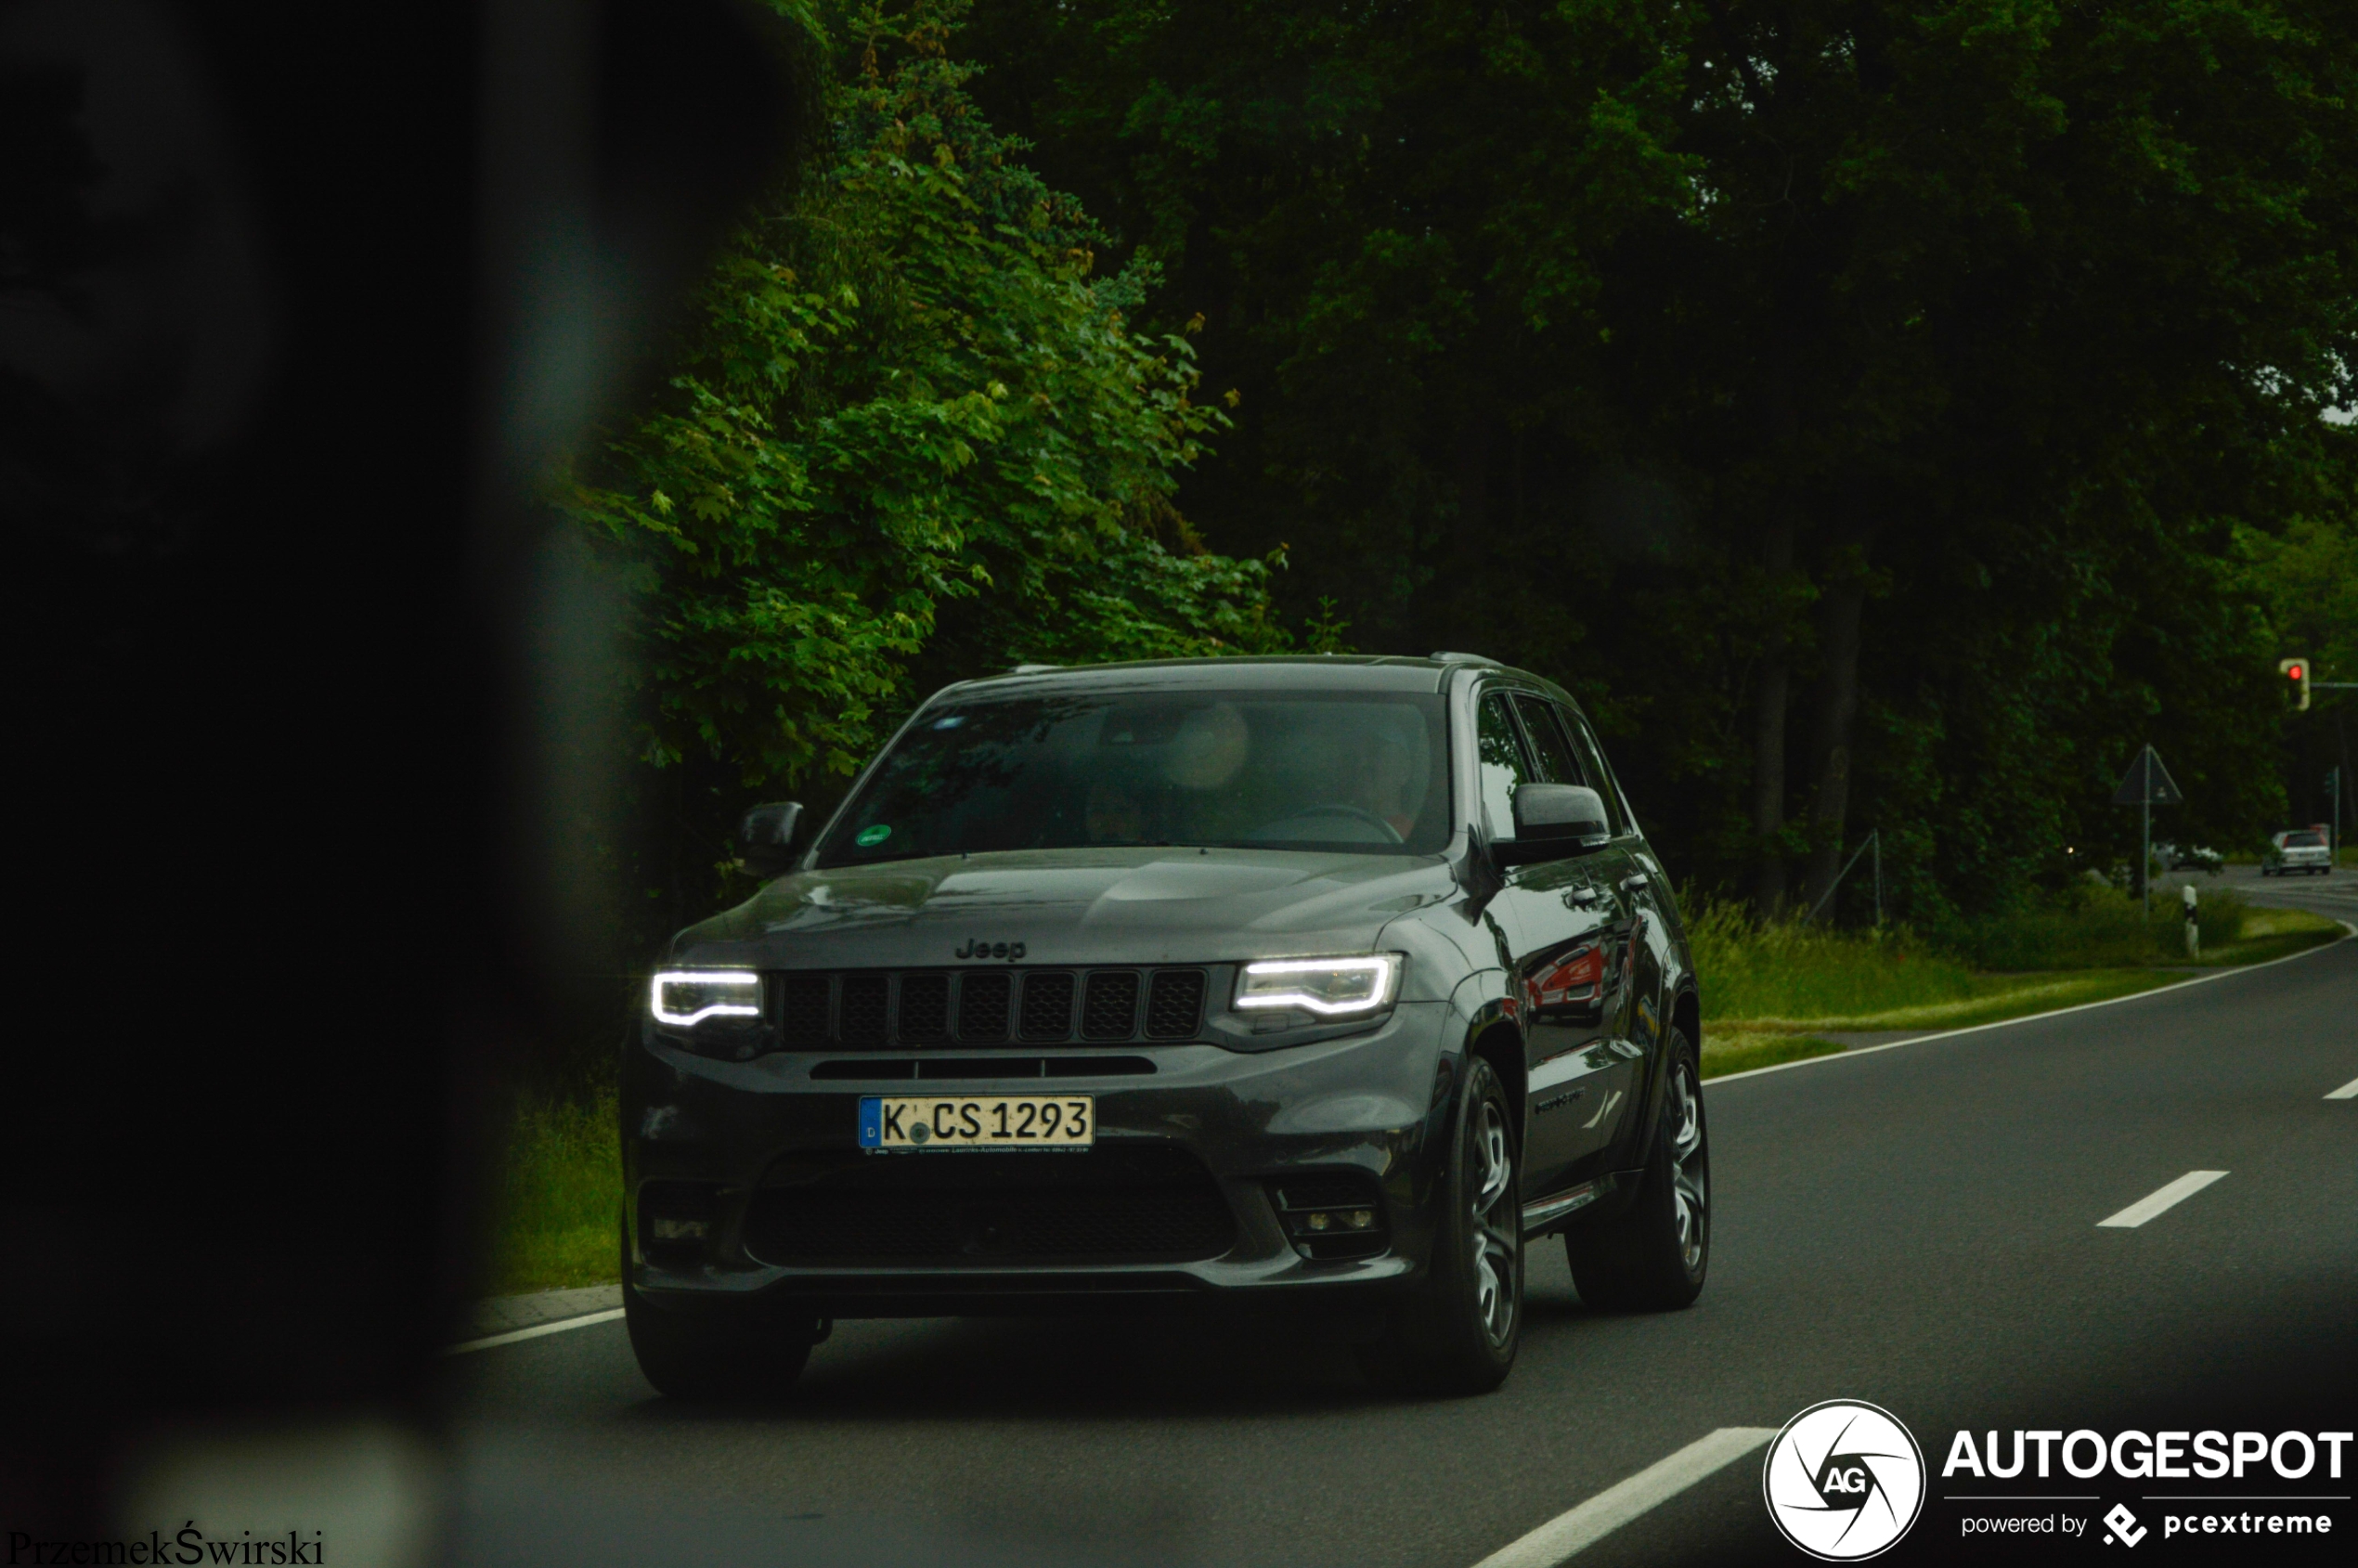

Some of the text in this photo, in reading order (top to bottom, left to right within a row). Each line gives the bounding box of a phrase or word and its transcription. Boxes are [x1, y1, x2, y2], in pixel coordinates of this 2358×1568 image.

[955, 938, 1027, 963] Jeep
[867, 1126, 875, 1138] D
[885, 1104, 906, 1139] K
